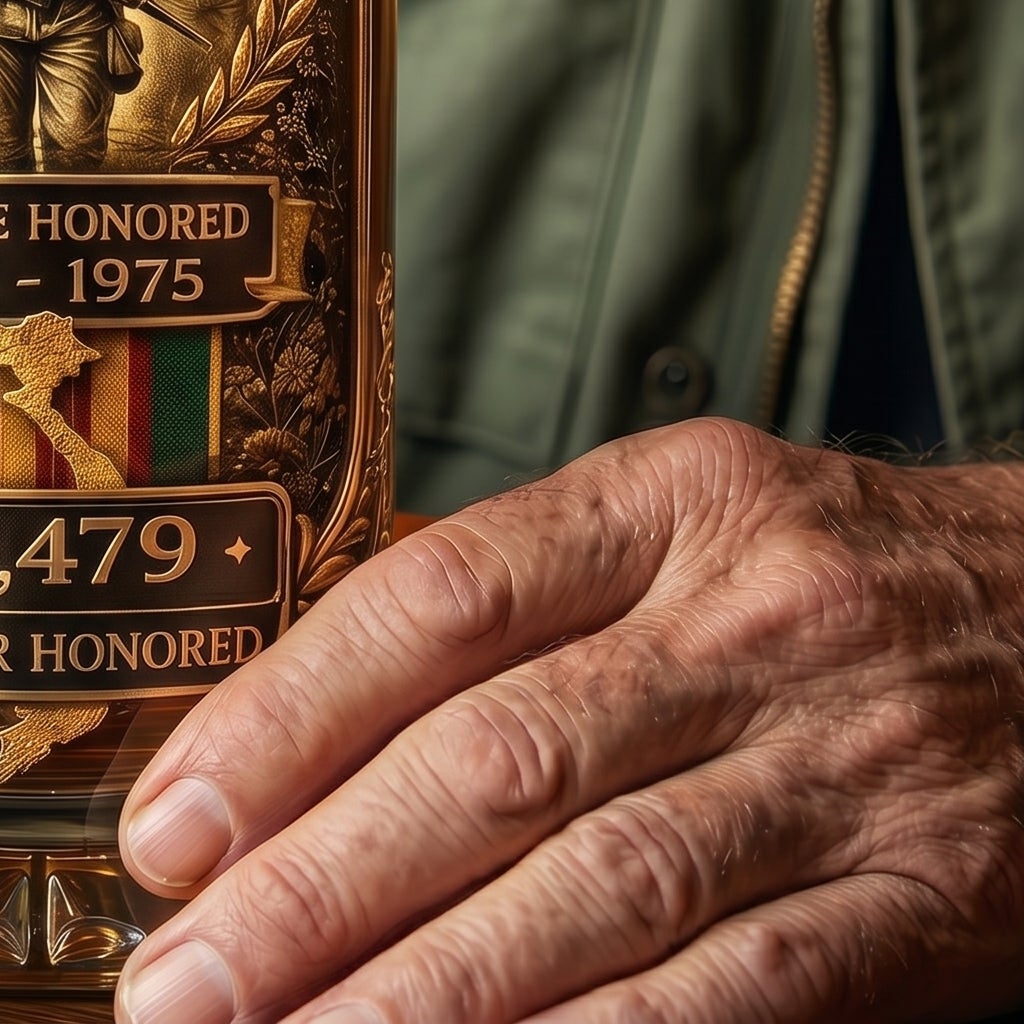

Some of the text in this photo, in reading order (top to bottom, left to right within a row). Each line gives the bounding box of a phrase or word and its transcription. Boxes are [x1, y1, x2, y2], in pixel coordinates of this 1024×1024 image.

[28, 202, 251, 242] HONORED
[67, 257, 205, 304] 1975
[30, 626, 263, 673] HONORED
